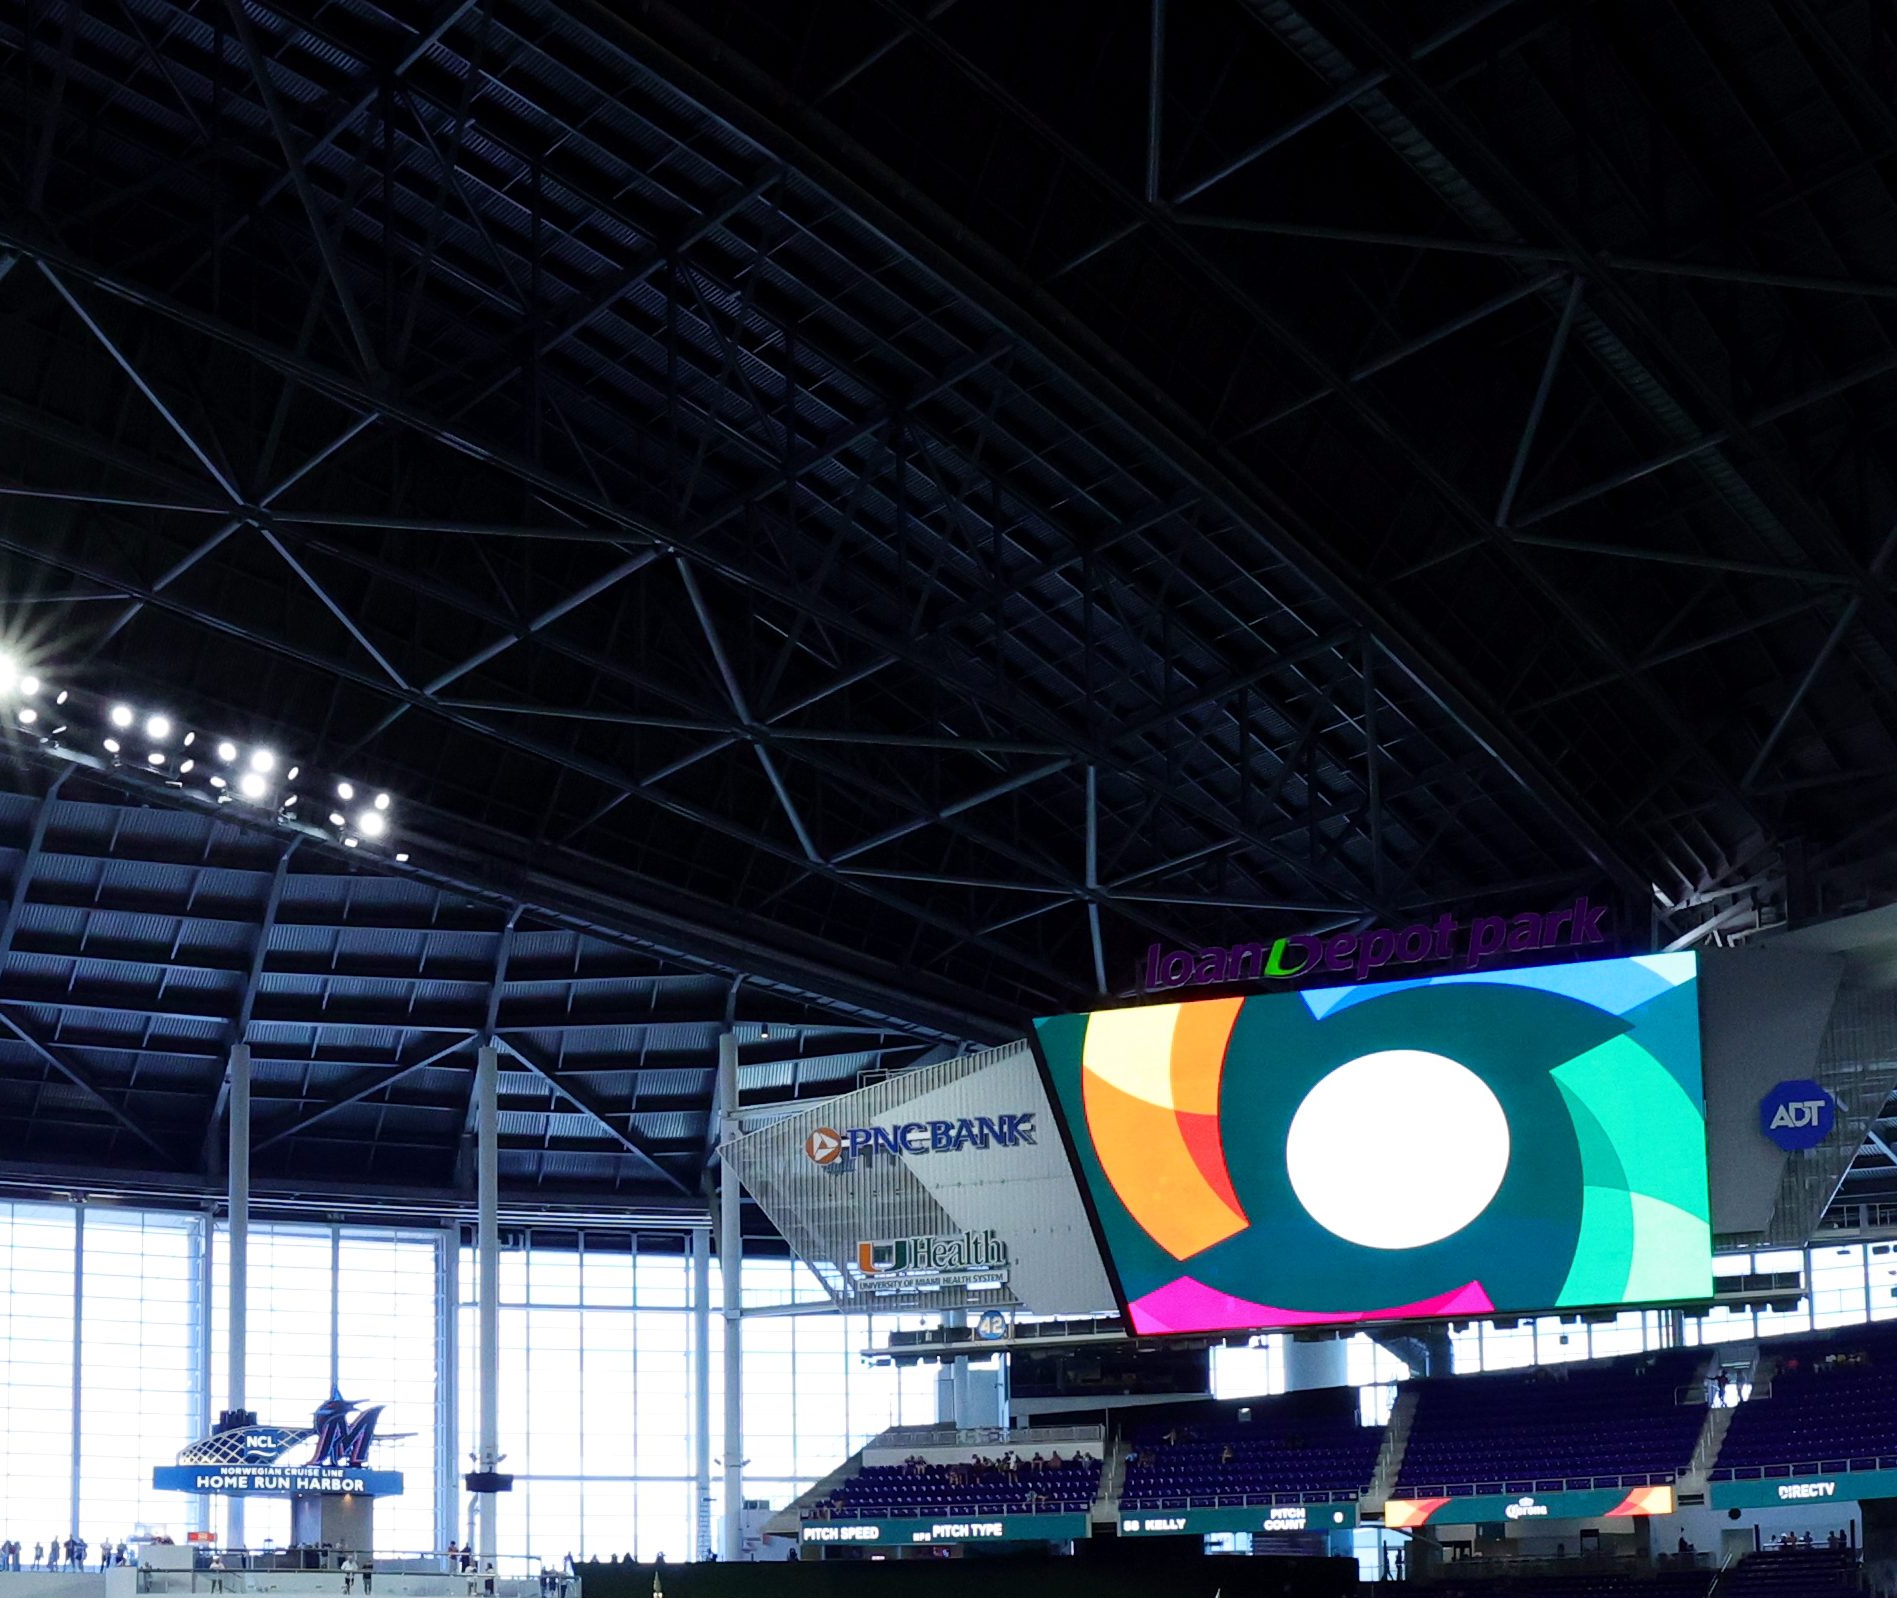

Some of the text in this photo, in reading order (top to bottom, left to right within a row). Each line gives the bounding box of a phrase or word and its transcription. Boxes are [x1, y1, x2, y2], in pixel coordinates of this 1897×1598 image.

[1146, 896, 1608, 989] loanDepot park
[1769, 1100, 1826, 1129] ADT
[859, 1273, 1004, 1290] UNIVERSITY OF MIAMI HEALTH SYSTEM
[978, 1317, 1003, 1333] 42
[246, 1435, 278, 1449] NCL
[220, 1467, 344, 1478] NORWEGIAN CRUISE LINE
[196, 1475, 365, 1492] HOME RUN HARBOR
[1778, 1482, 1836, 1500] DIRECTV
[1145, 1518, 1187, 1531] KELLY
[1270, 1507, 1306, 1519] PITCH
[1505, 1504, 1548, 1519] Corona
[804, 1527, 839, 1541] PITCH
[840, 1526, 879, 1540] SPEED
[932, 1523, 969, 1538] PITCH
[971, 1522, 1003, 1536] TYPE
[1263, 1518, 1306, 1531] COUNT
